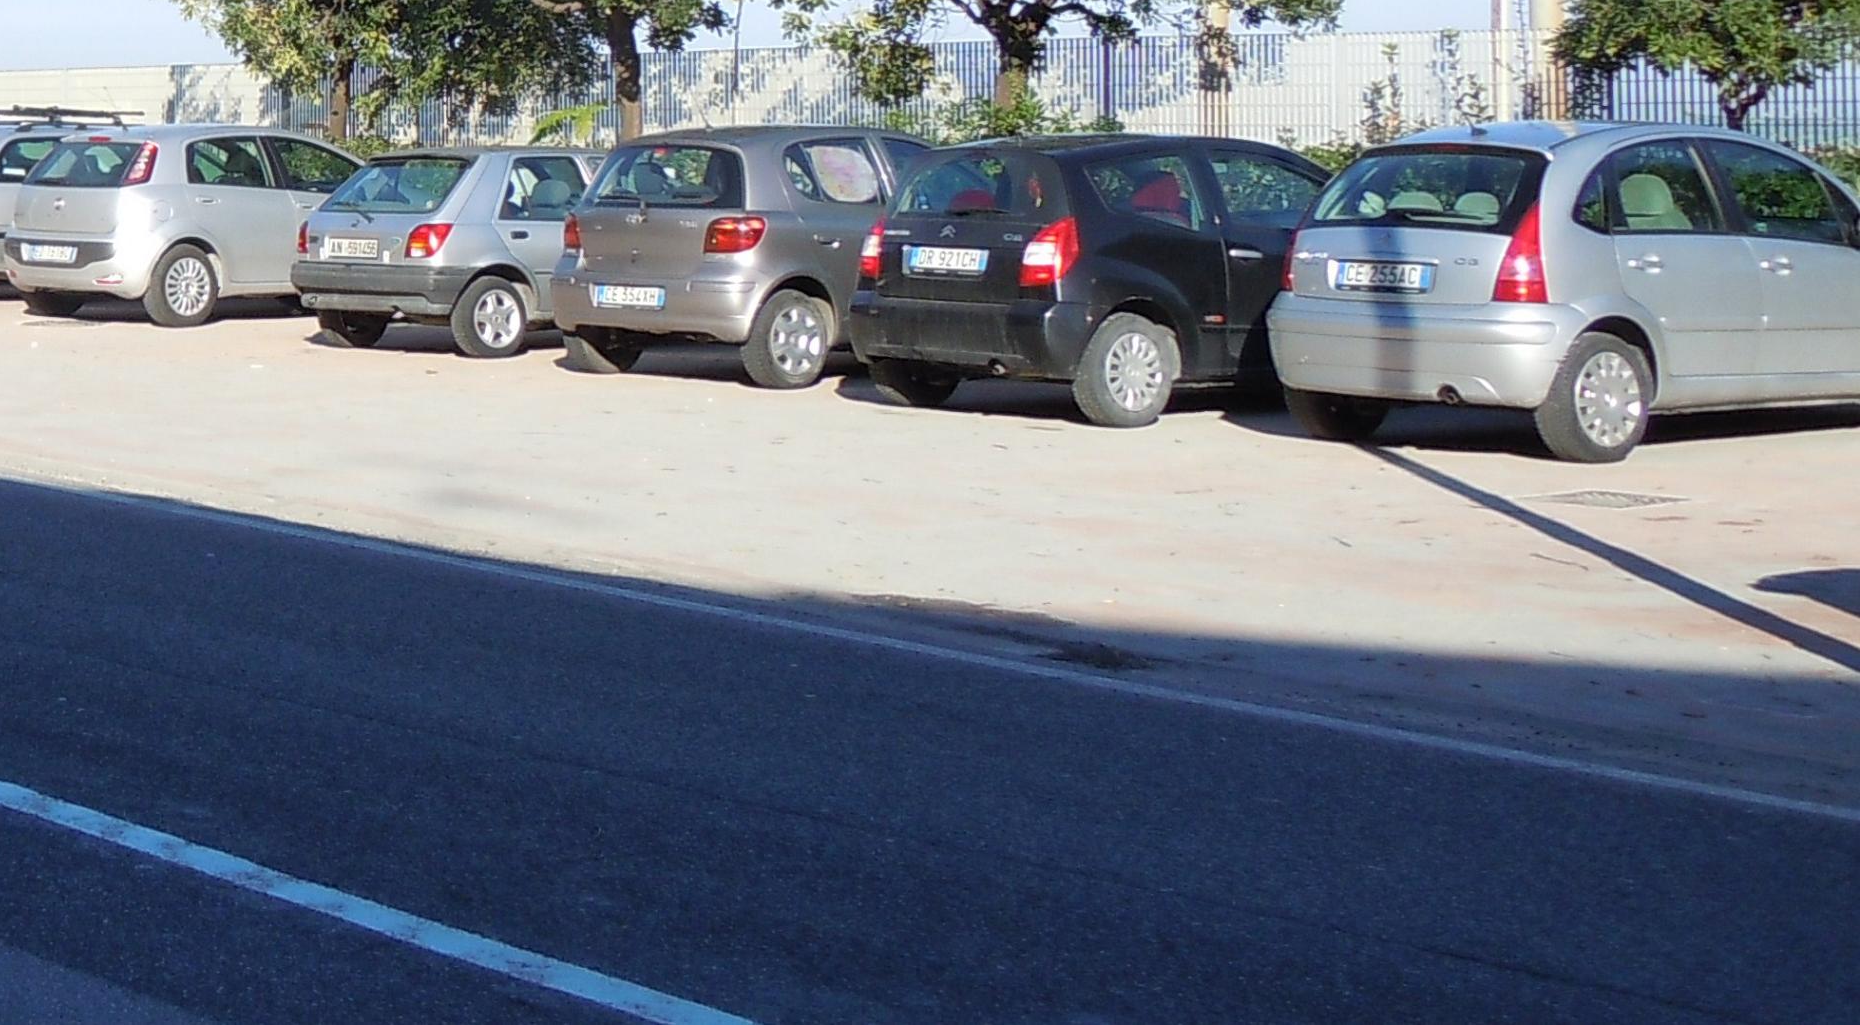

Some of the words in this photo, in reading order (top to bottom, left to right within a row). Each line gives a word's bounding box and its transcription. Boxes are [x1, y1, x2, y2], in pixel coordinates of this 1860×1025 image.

[918, 249, 934, 265] DR
[939, 250, 978, 267] 921CH
[1454, 257, 1479, 266] C3
[1345, 264, 1365, 282] CE
[1368, 266, 1418, 285] 255AC
[604, 287, 618, 302] CE
